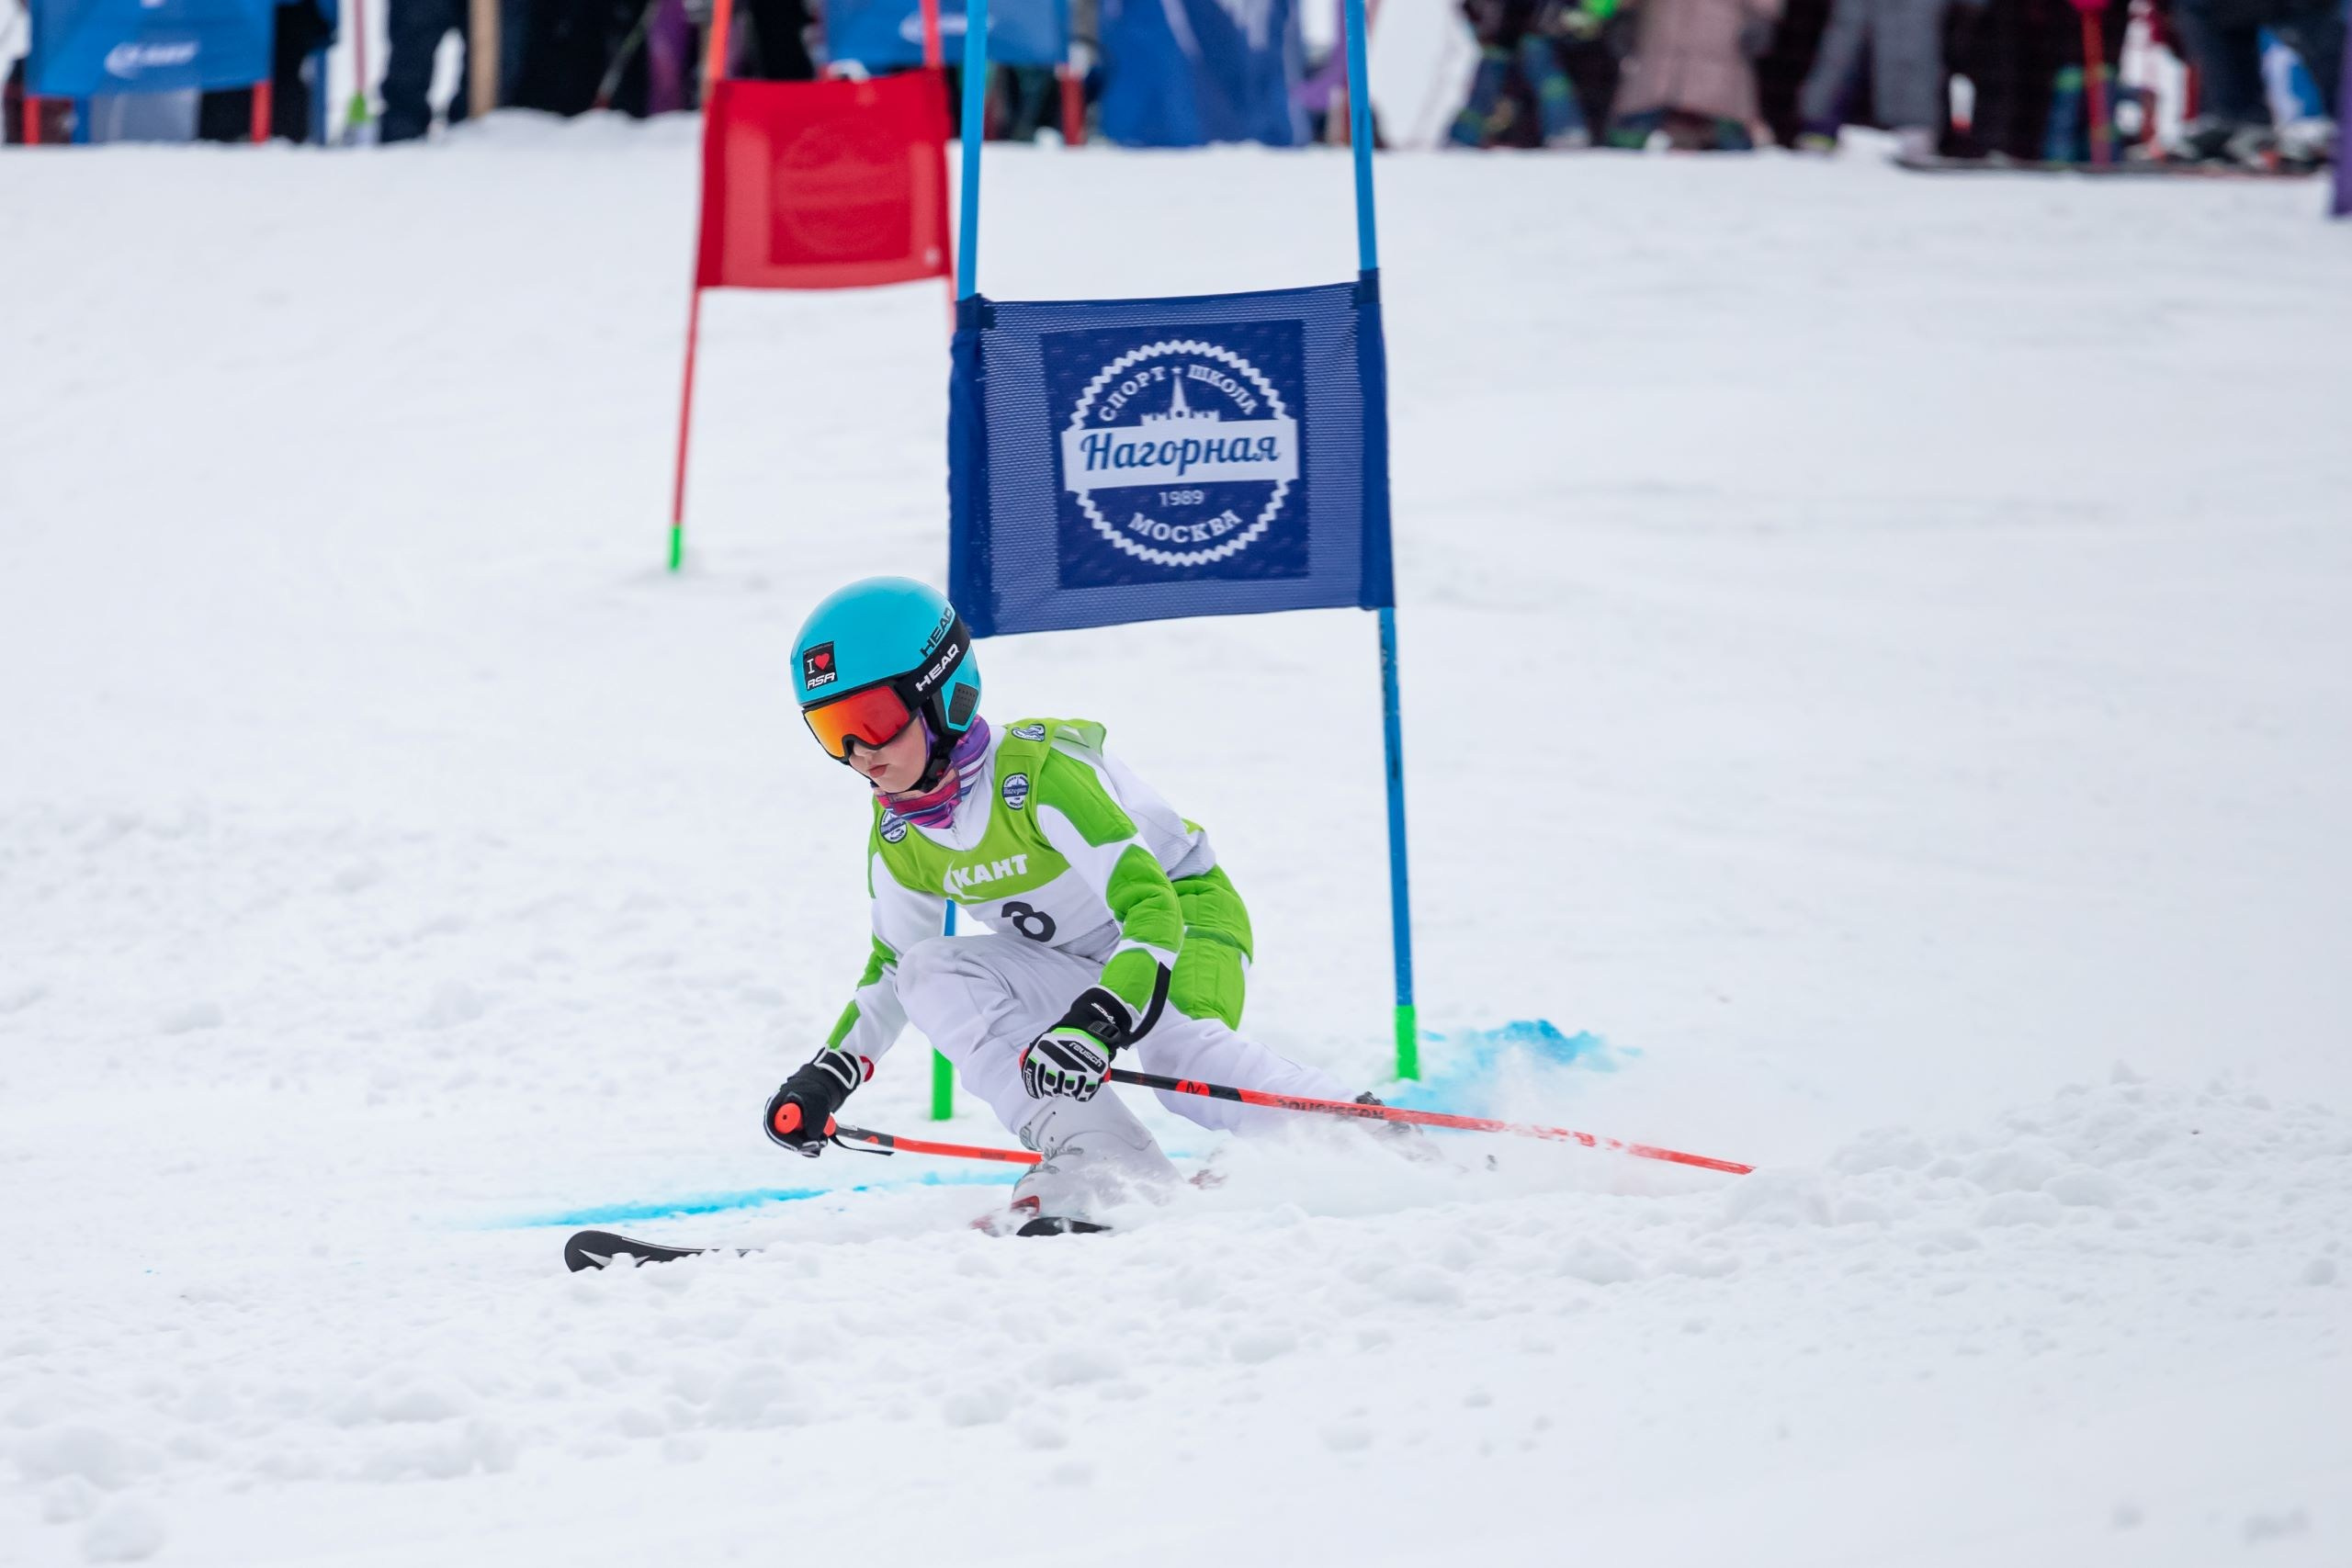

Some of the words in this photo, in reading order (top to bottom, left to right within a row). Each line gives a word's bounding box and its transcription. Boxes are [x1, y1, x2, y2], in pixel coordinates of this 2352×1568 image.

[1099, 367, 1166, 422] СПОРТ
[1186, 364, 1258, 414] ШКОЛА
[1080, 432, 1280, 477] Нагорная
[1159, 490, 1204, 506] 1989
[1127, 509, 1242, 544] МОСКВА
[807, 658, 815, 674] I
[915, 643, 960, 692] HEAD
[952, 853, 1028, 888] КАНТ
[1069, 1042, 1104, 1067] reusch
